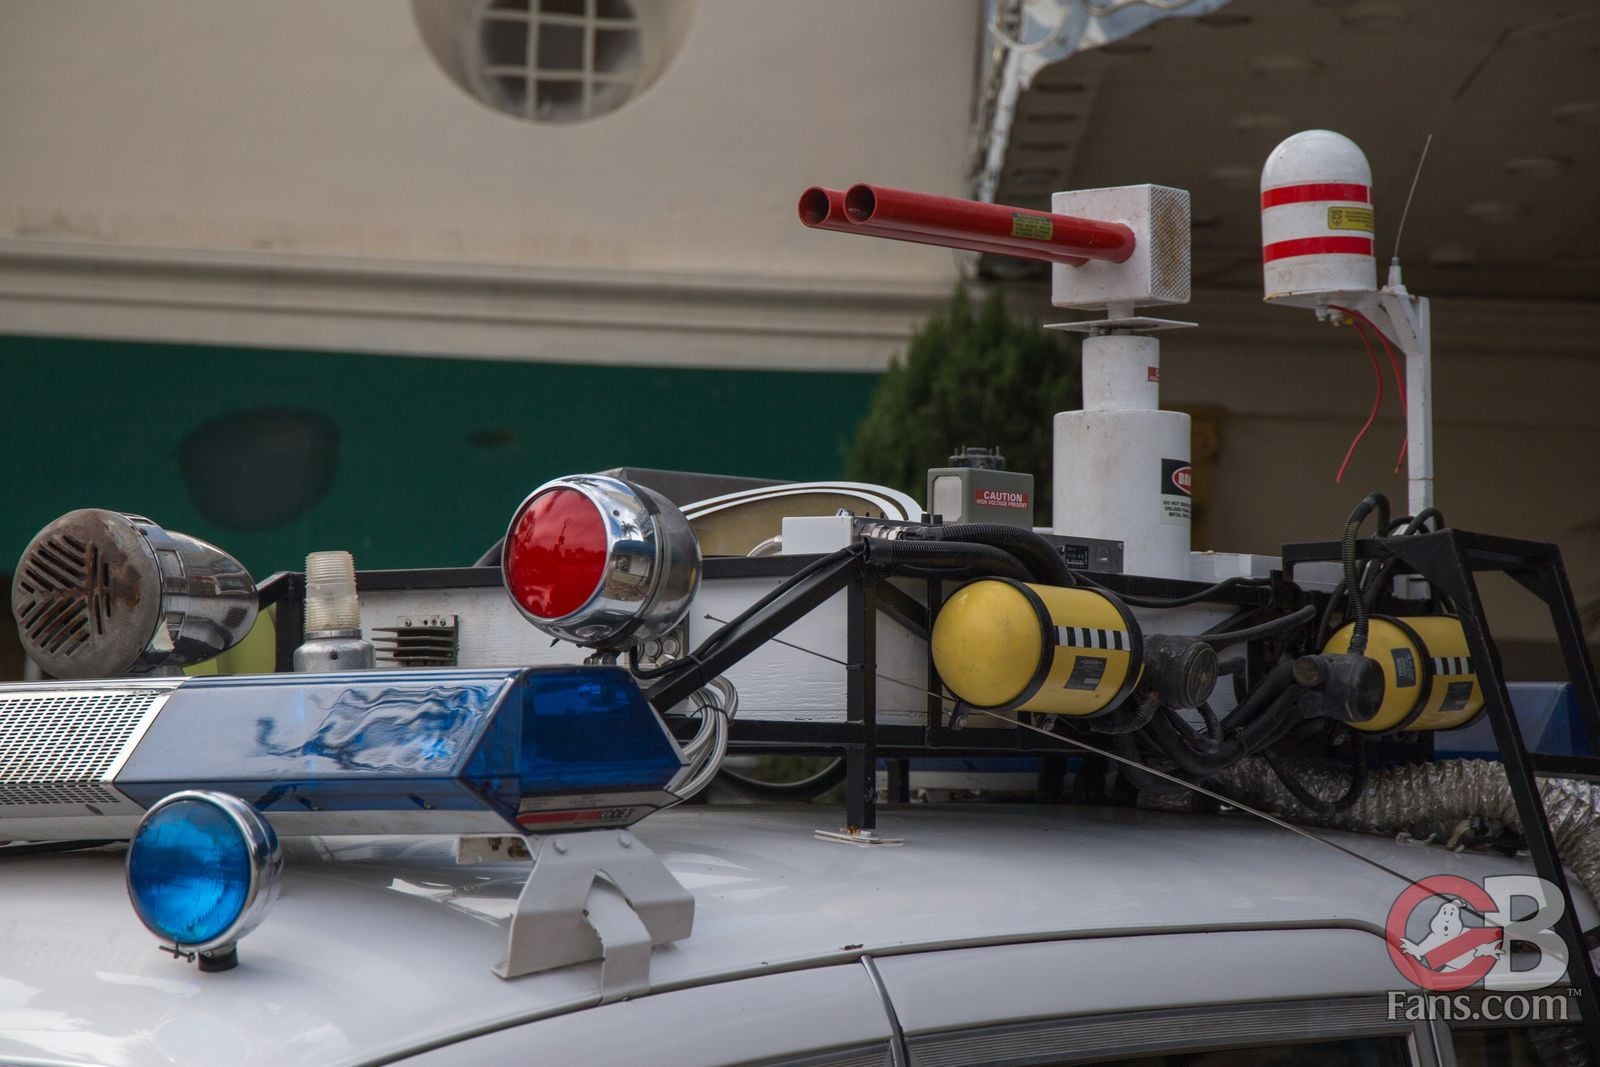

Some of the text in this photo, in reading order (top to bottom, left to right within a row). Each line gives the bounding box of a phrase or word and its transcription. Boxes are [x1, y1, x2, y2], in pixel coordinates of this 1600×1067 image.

[983, 490, 1023, 503] CAUTION
[989, 499, 1007, 507] VOLTAGE
[1008, 501, 1028, 509] PRESENT
[599, 808, 625, 820] CODE
